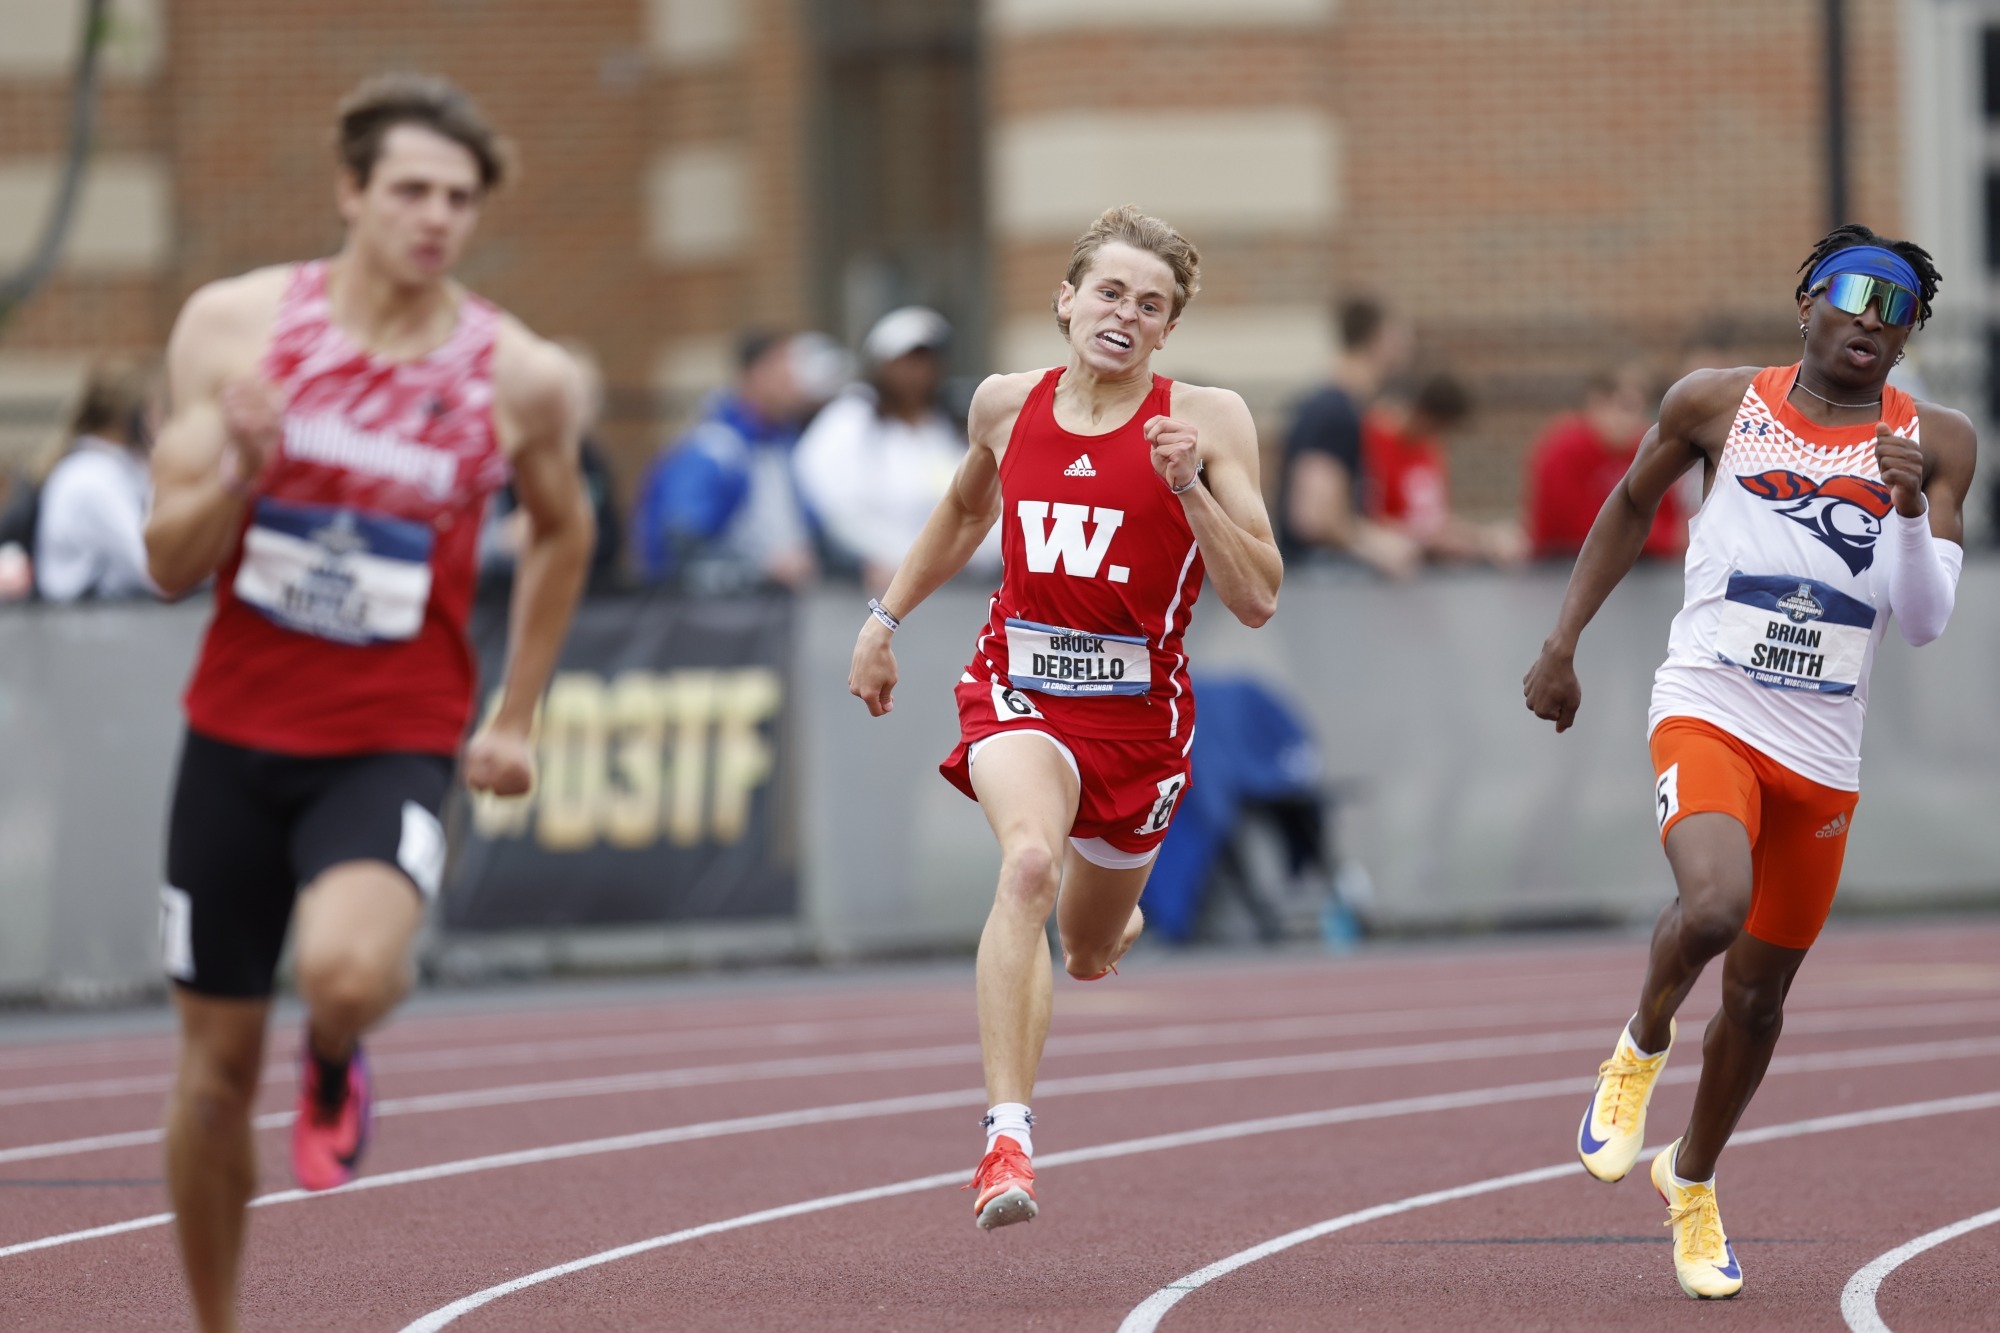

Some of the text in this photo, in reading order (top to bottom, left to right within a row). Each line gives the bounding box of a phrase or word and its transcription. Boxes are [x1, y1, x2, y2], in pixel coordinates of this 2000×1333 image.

[1063, 467, 1097, 477] adidas
[1049, 636, 1105, 654] BROCK
[1765, 620, 1822, 649] BRIAN
[1032, 653, 1125, 681] DEBELLO
[1746, 669, 1755, 679] LA
[1750, 643, 1825, 678] SMITH
[1041, 681, 1051, 689] LA
[1076, 683, 1114, 692] WISCONSIN
[1002, 687, 1032, 715] 6
[1152, 781, 1181, 830] 6
